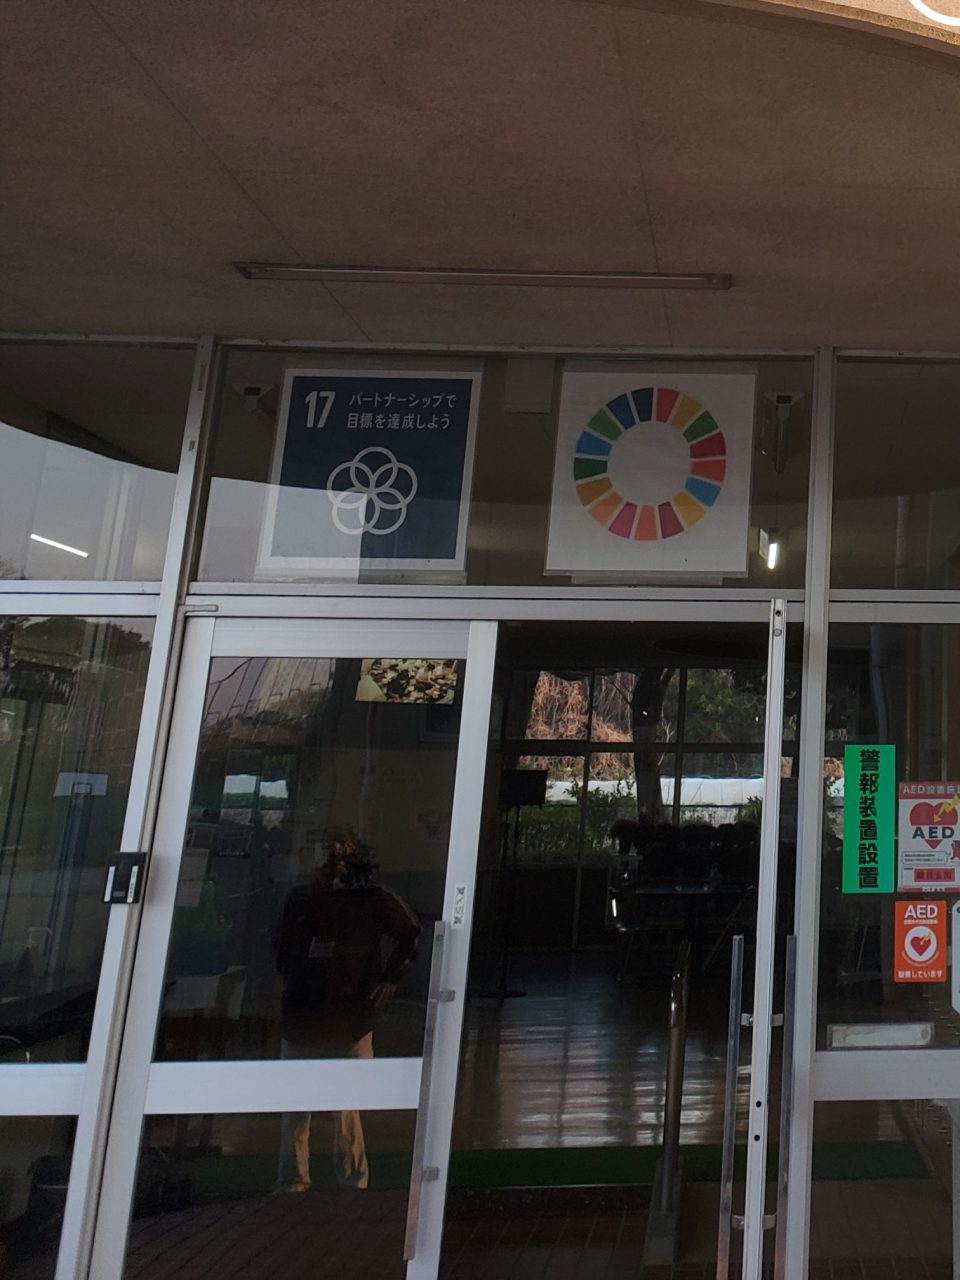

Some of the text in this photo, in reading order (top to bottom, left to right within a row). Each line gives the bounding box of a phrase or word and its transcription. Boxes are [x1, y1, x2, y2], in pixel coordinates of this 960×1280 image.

[348, 391, 458, 409] パートナーシップで
[305, 390, 337, 429] 17
[346, 412, 451, 430] 目標を達成しよう
[858, 749, 880, 888] 警報装置設置
[912, 826, 955, 840] AED
[905, 904, 938, 918] AED
